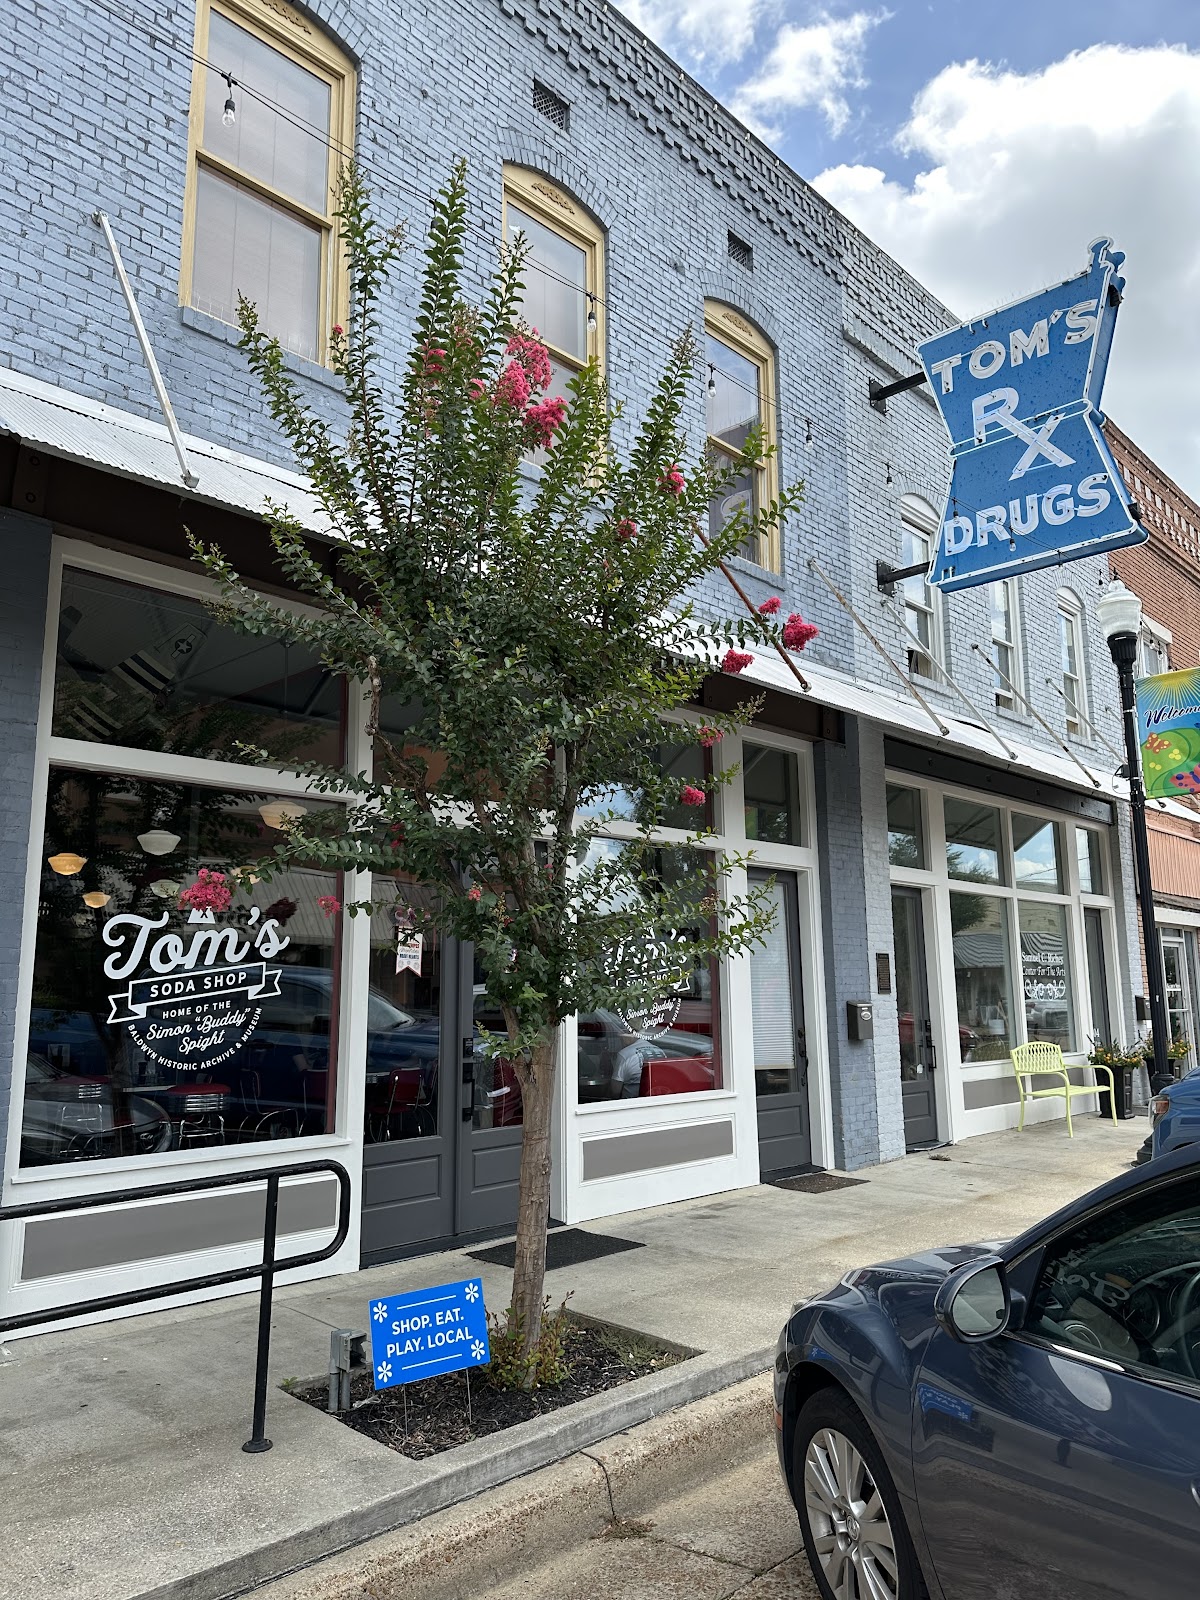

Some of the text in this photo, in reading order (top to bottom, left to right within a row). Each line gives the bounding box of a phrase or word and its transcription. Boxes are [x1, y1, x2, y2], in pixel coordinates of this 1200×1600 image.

[931, 298, 1099, 395] TOM'S
[943, 472, 1112, 557] DRUGS
[102, 906, 291, 980] Tom's
[150, 971, 248, 998] SODA SHOP
[162, 1000, 232, 1019] HOME OF THE
[127, 1023, 158, 1060] BALDWYN
[157, 1055, 198, 1071] HISTORIC
[200, 1047, 236, 1070] ARCHIVE
[241, 1007, 263, 1043] MUSEUM
[146, 1023, 193, 1041] Simon
[178, 1029, 227, 1055] Spight
[391, 1307, 464, 1335] SHOP. EAT.
[386, 1326, 473, 1359] PLAY. LOCAL
